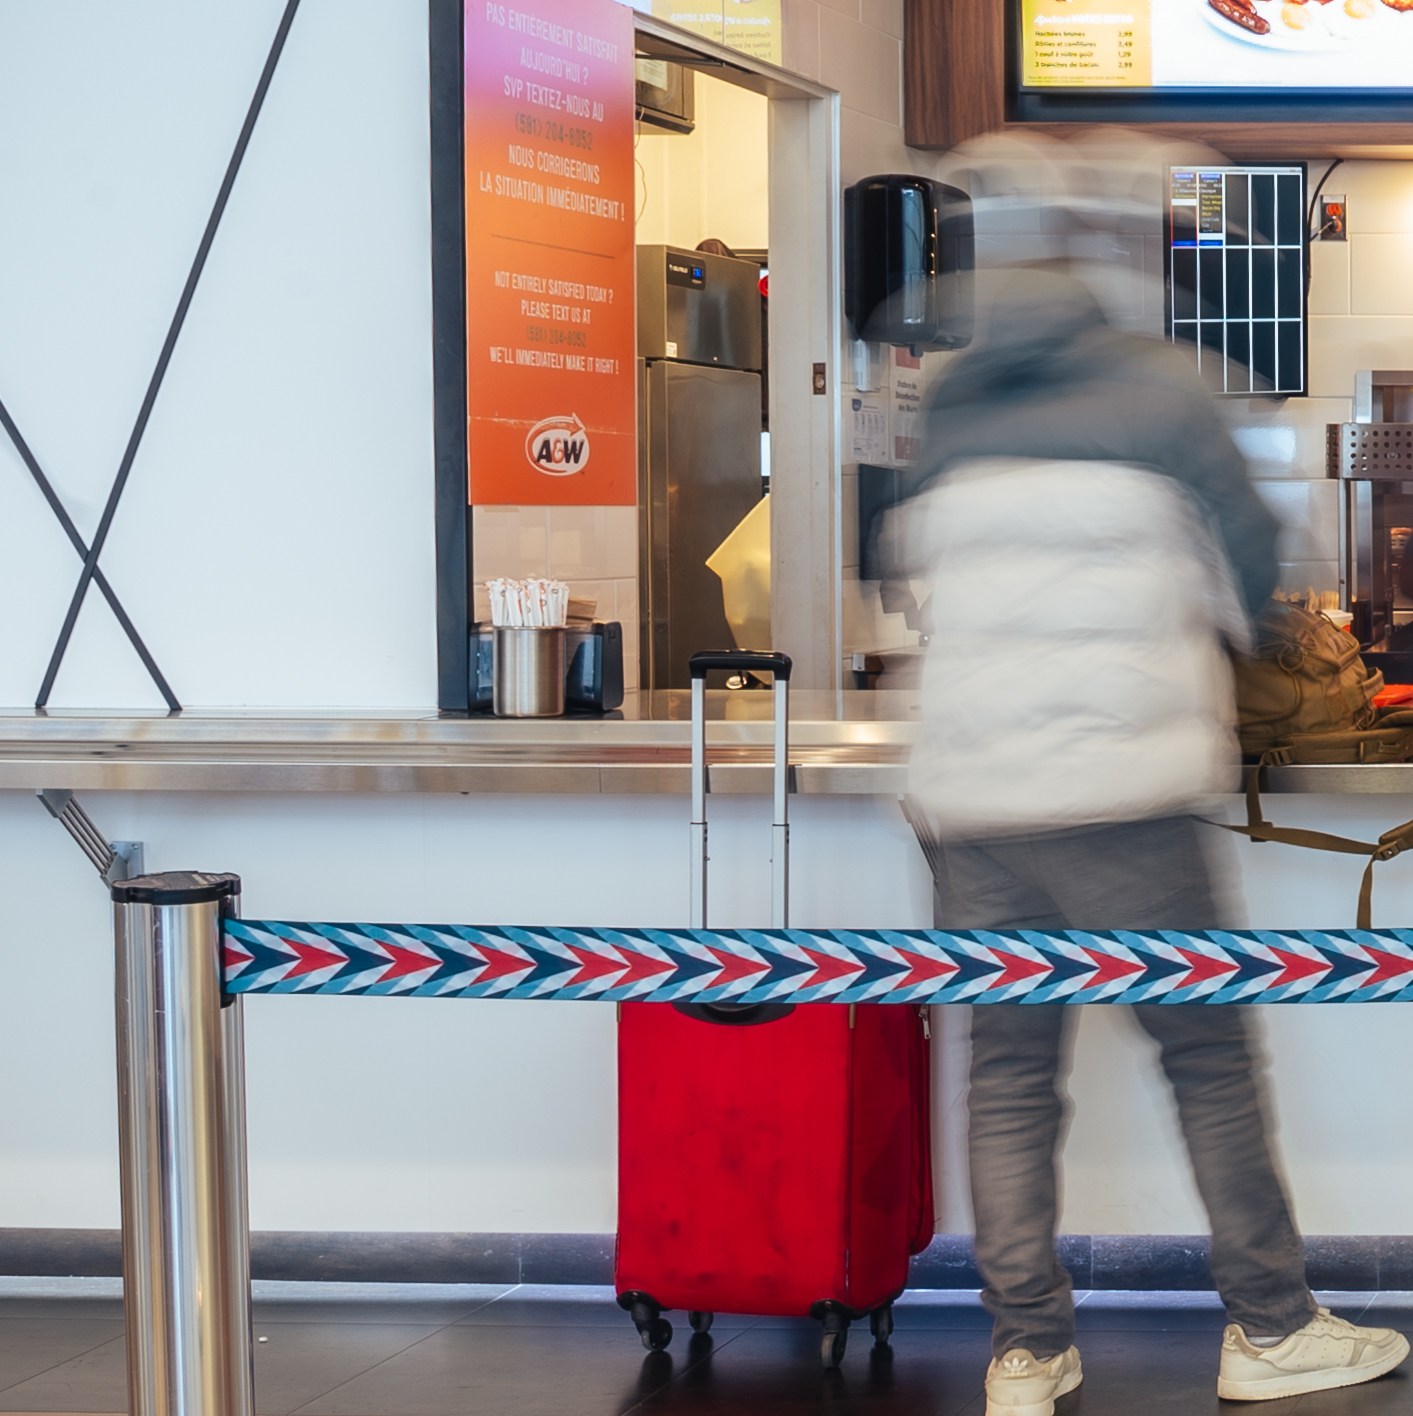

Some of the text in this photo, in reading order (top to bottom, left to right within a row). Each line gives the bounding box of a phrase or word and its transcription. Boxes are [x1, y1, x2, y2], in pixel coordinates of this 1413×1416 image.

[486, 1, 618, 64] PAS ENTIÈREMENT SATISFAIT
[520, 46, 590, 86] AUJOURD'HUI ?
[503, 75, 604, 123] SVP TEXTEZ-NOUS AU
[508, 144, 600, 185] NOUS CORRIGERONS
[479, 170, 493, 193] LA
[495, 174, 545, 205] SITUATION
[546, 186, 619, 221] IMMÉDIATEMENT
[494, 270, 510, 289] NOT
[511, 273, 547, 294] ENTIRELY
[547, 278, 585, 300] SATISFIED
[586, 284, 608, 304] TODAY
[521, 299, 592, 325] PLEASE TEXT US AT
[489, 346, 514, 364] WE'LL
[515, 348, 564, 370] IMMEDIATELY
[565, 354, 586, 372] MAKE
[586, 356, 594, 373] IT
[595, 357, 615, 374] RIGHT
[535, 437, 586, 465] A&W
